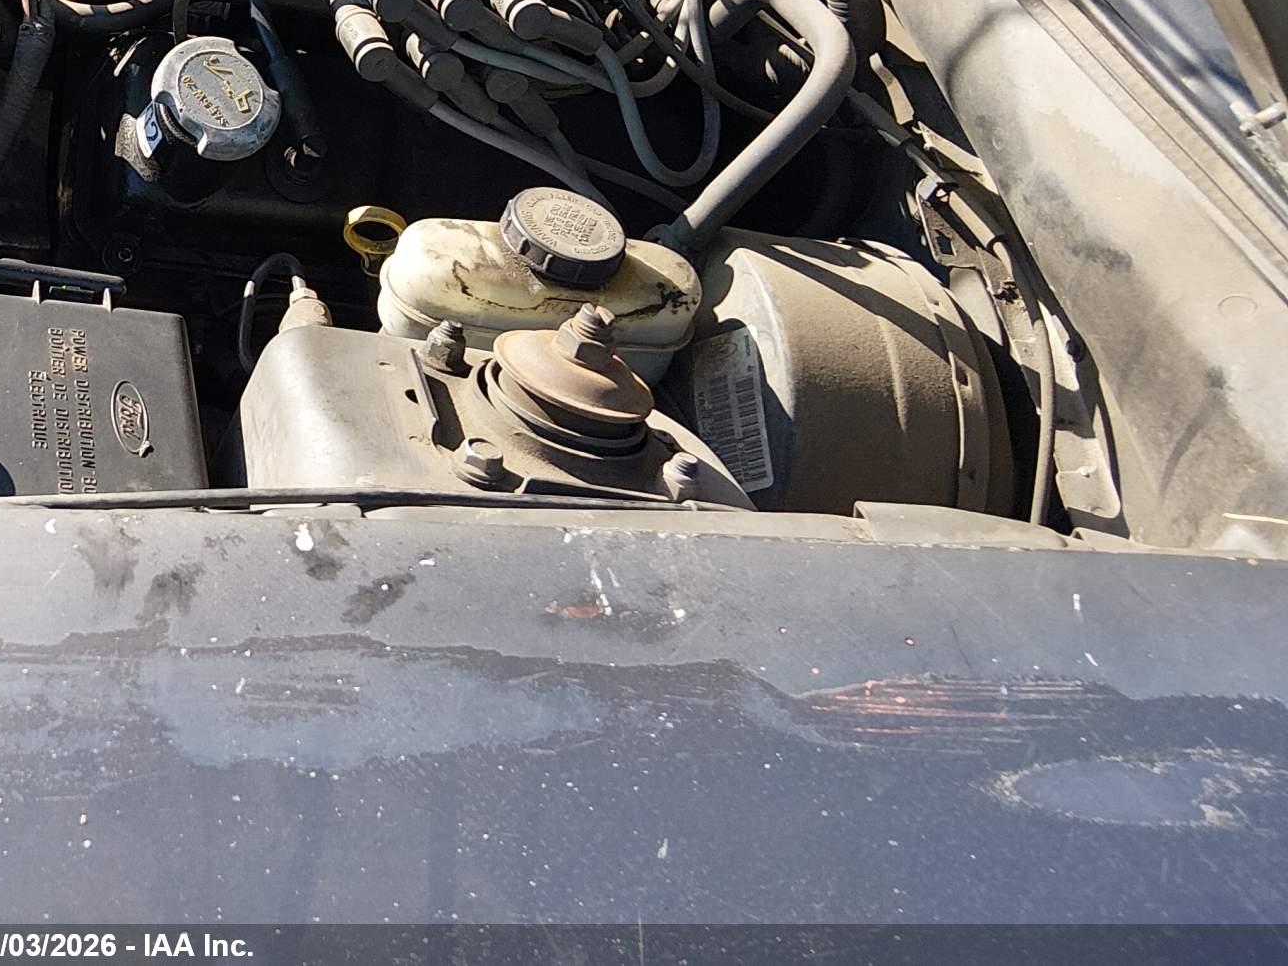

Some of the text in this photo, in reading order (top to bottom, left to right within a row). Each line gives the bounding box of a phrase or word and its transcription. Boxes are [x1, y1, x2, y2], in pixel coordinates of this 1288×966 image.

[71, 329, 88, 372] POWER
[28, 369, 52, 449] ÉLECTRIQUE
[51, 382, 68, 401] DE
[73, 379, 95, 469] DISTRIBUTION
[117, 394, 144, 439] Ford
